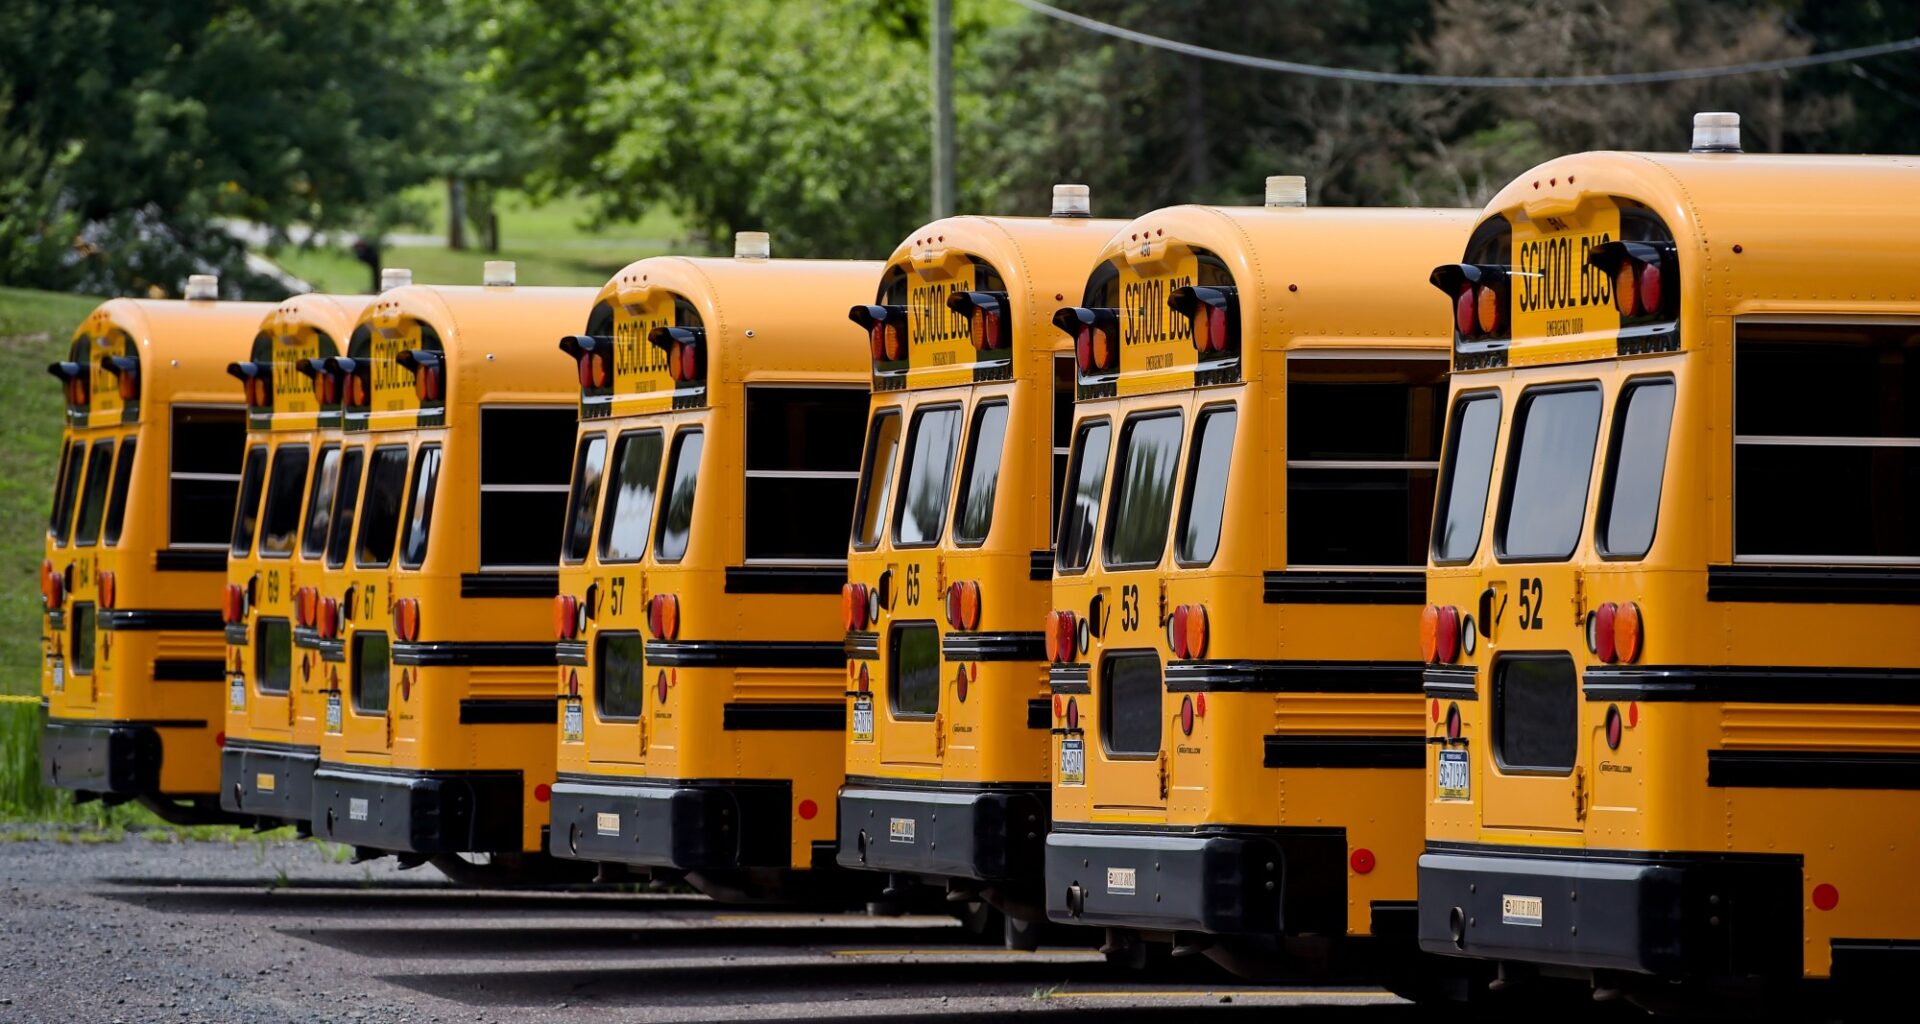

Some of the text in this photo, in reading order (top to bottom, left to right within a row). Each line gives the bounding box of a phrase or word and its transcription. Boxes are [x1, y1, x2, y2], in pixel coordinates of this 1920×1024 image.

[1520, 233, 1611, 312] SCHOOL BUS
[913, 284, 948, 344] SCHOOL
[1125, 279, 1166, 345] SCHOOL
[1546, 317, 1583, 337] EMERGENCY DOOR
[617, 320, 649, 375] SCHOOL
[268, 571, 279, 603] 69
[365, 585, 376, 620] 67
[611, 577, 625, 616] 57
[906, 563, 920, 606] 65
[1519, 577, 1543, 630] 52
[1121, 585, 1139, 632] 53
